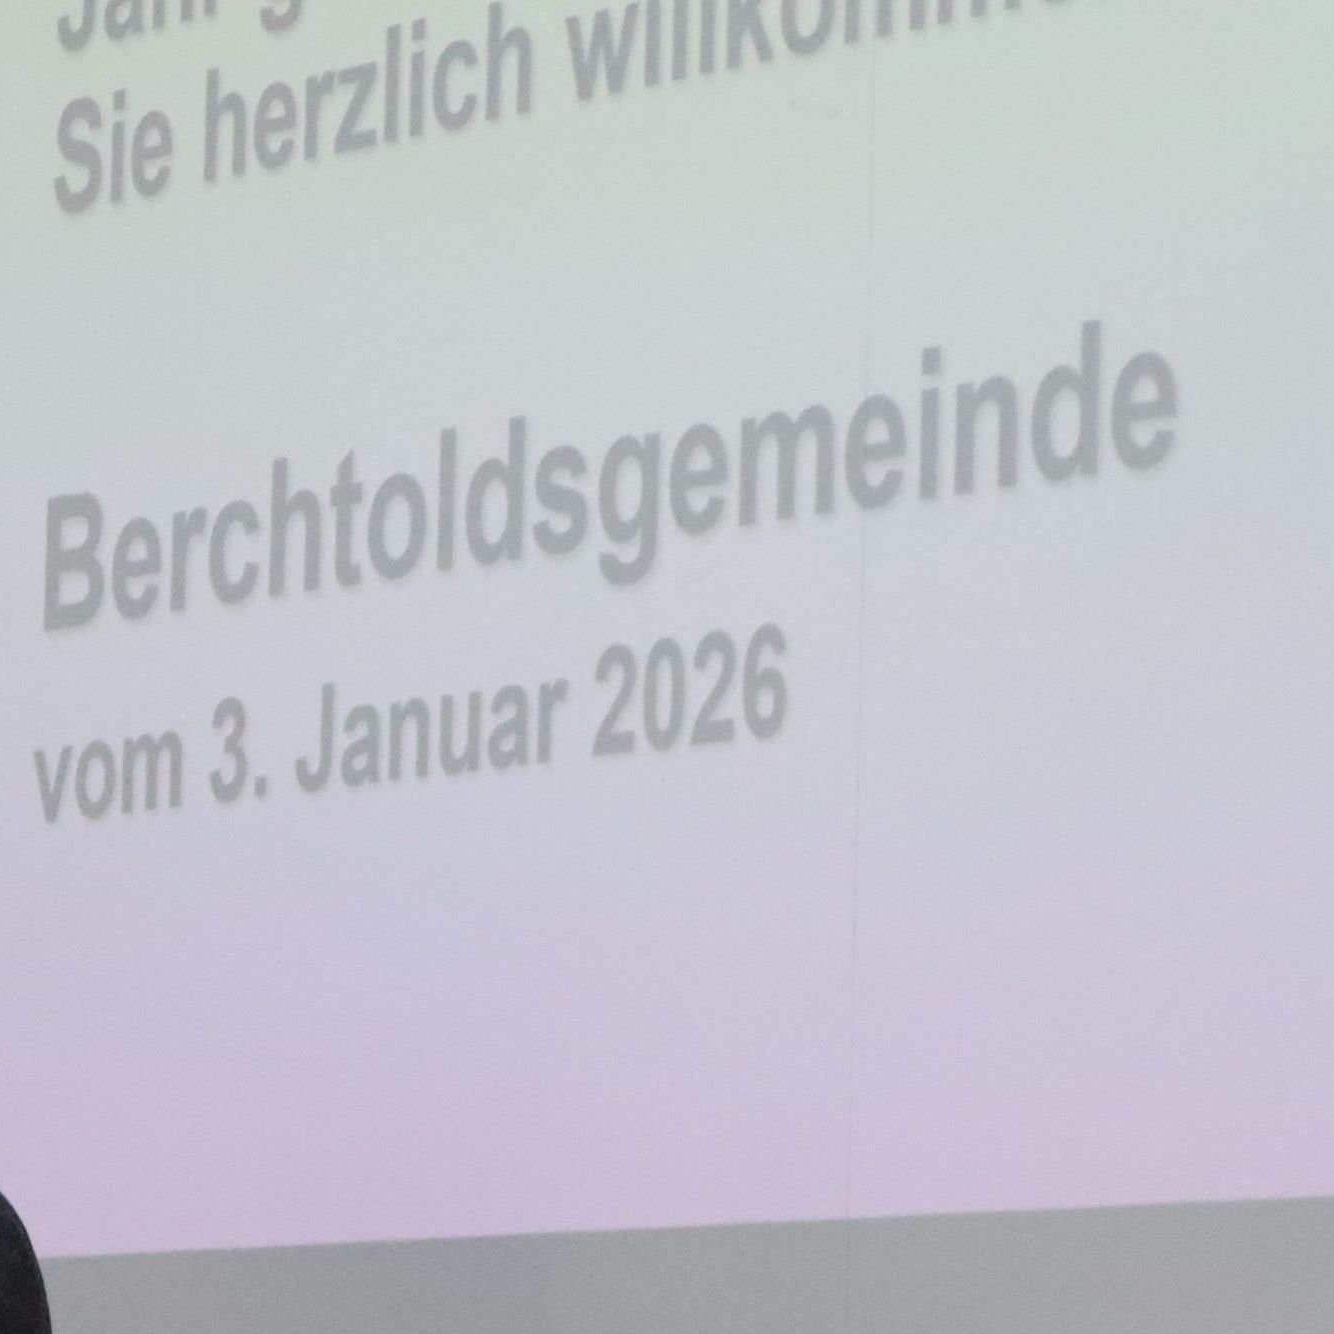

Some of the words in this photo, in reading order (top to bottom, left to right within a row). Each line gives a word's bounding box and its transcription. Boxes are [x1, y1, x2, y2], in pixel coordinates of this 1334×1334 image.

[54, 90, 174, 215] Sie
[204, 2, 533, 184] herzlich
[44, 320, 1179, 633] Berchtoldsgemeinde
[33, 731, 184, 825] vom
[210, 697, 268, 805] 3.
[295, 679, 570, 794] Januar
[593, 624, 787, 757] 2026
